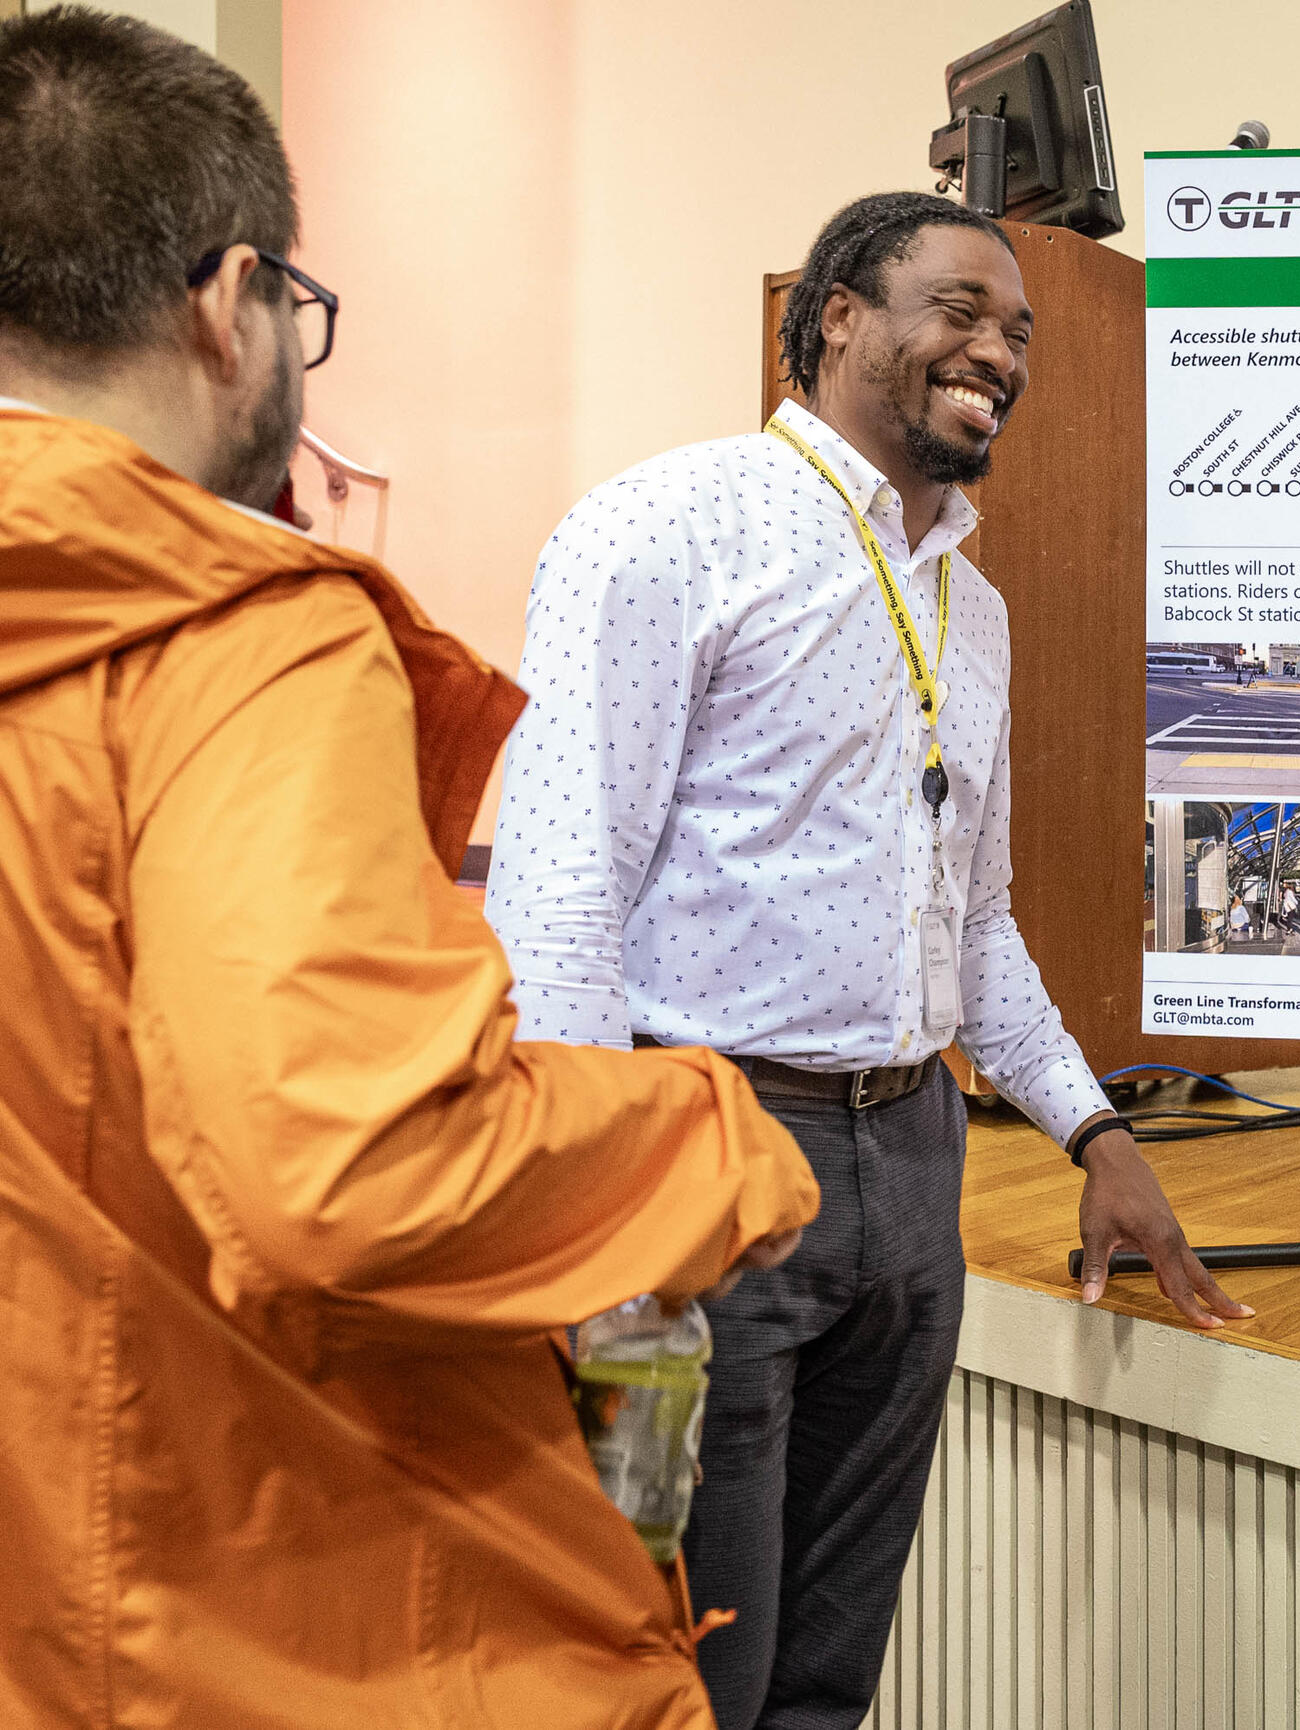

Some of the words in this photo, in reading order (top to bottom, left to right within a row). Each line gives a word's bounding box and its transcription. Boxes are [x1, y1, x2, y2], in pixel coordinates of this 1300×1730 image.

[1170, 328, 1256, 344] Accessible
[1171, 351, 1241, 367] between
[1173, 445, 1204, 477] BOSTON
[1203, 413, 1237, 446] COLLEGE
[1232, 437, 1269, 476] CHESTNUT
[1268, 422, 1287, 439] HILL
[1203, 449, 1230, 477] SOUTH
[1228, 439, 1238, 452] ST
[1261, 439, 1298, 476] CHISWICK
[1164, 560, 1230, 575] Shuttles
[1235, 560, 1261, 575] will
[1268, 562, 1295, 576] not
[1164, 583, 1231, 598] stations.
[1238, 583, 1288, 599] Riders
[869, 540, 878, 557] See
[876, 559, 899, 610] Something,
[895, 612, 907, 629] Say
[902, 631, 923, 680] Something
[1165, 605, 1232, 621] Babcock
[1238, 606, 1253, 621] St
[1154, 994, 1192, 1006] Green
[1197, 995, 1224, 1008] Line
[1153, 1011, 1254, 1026] GLT@mbta.com
